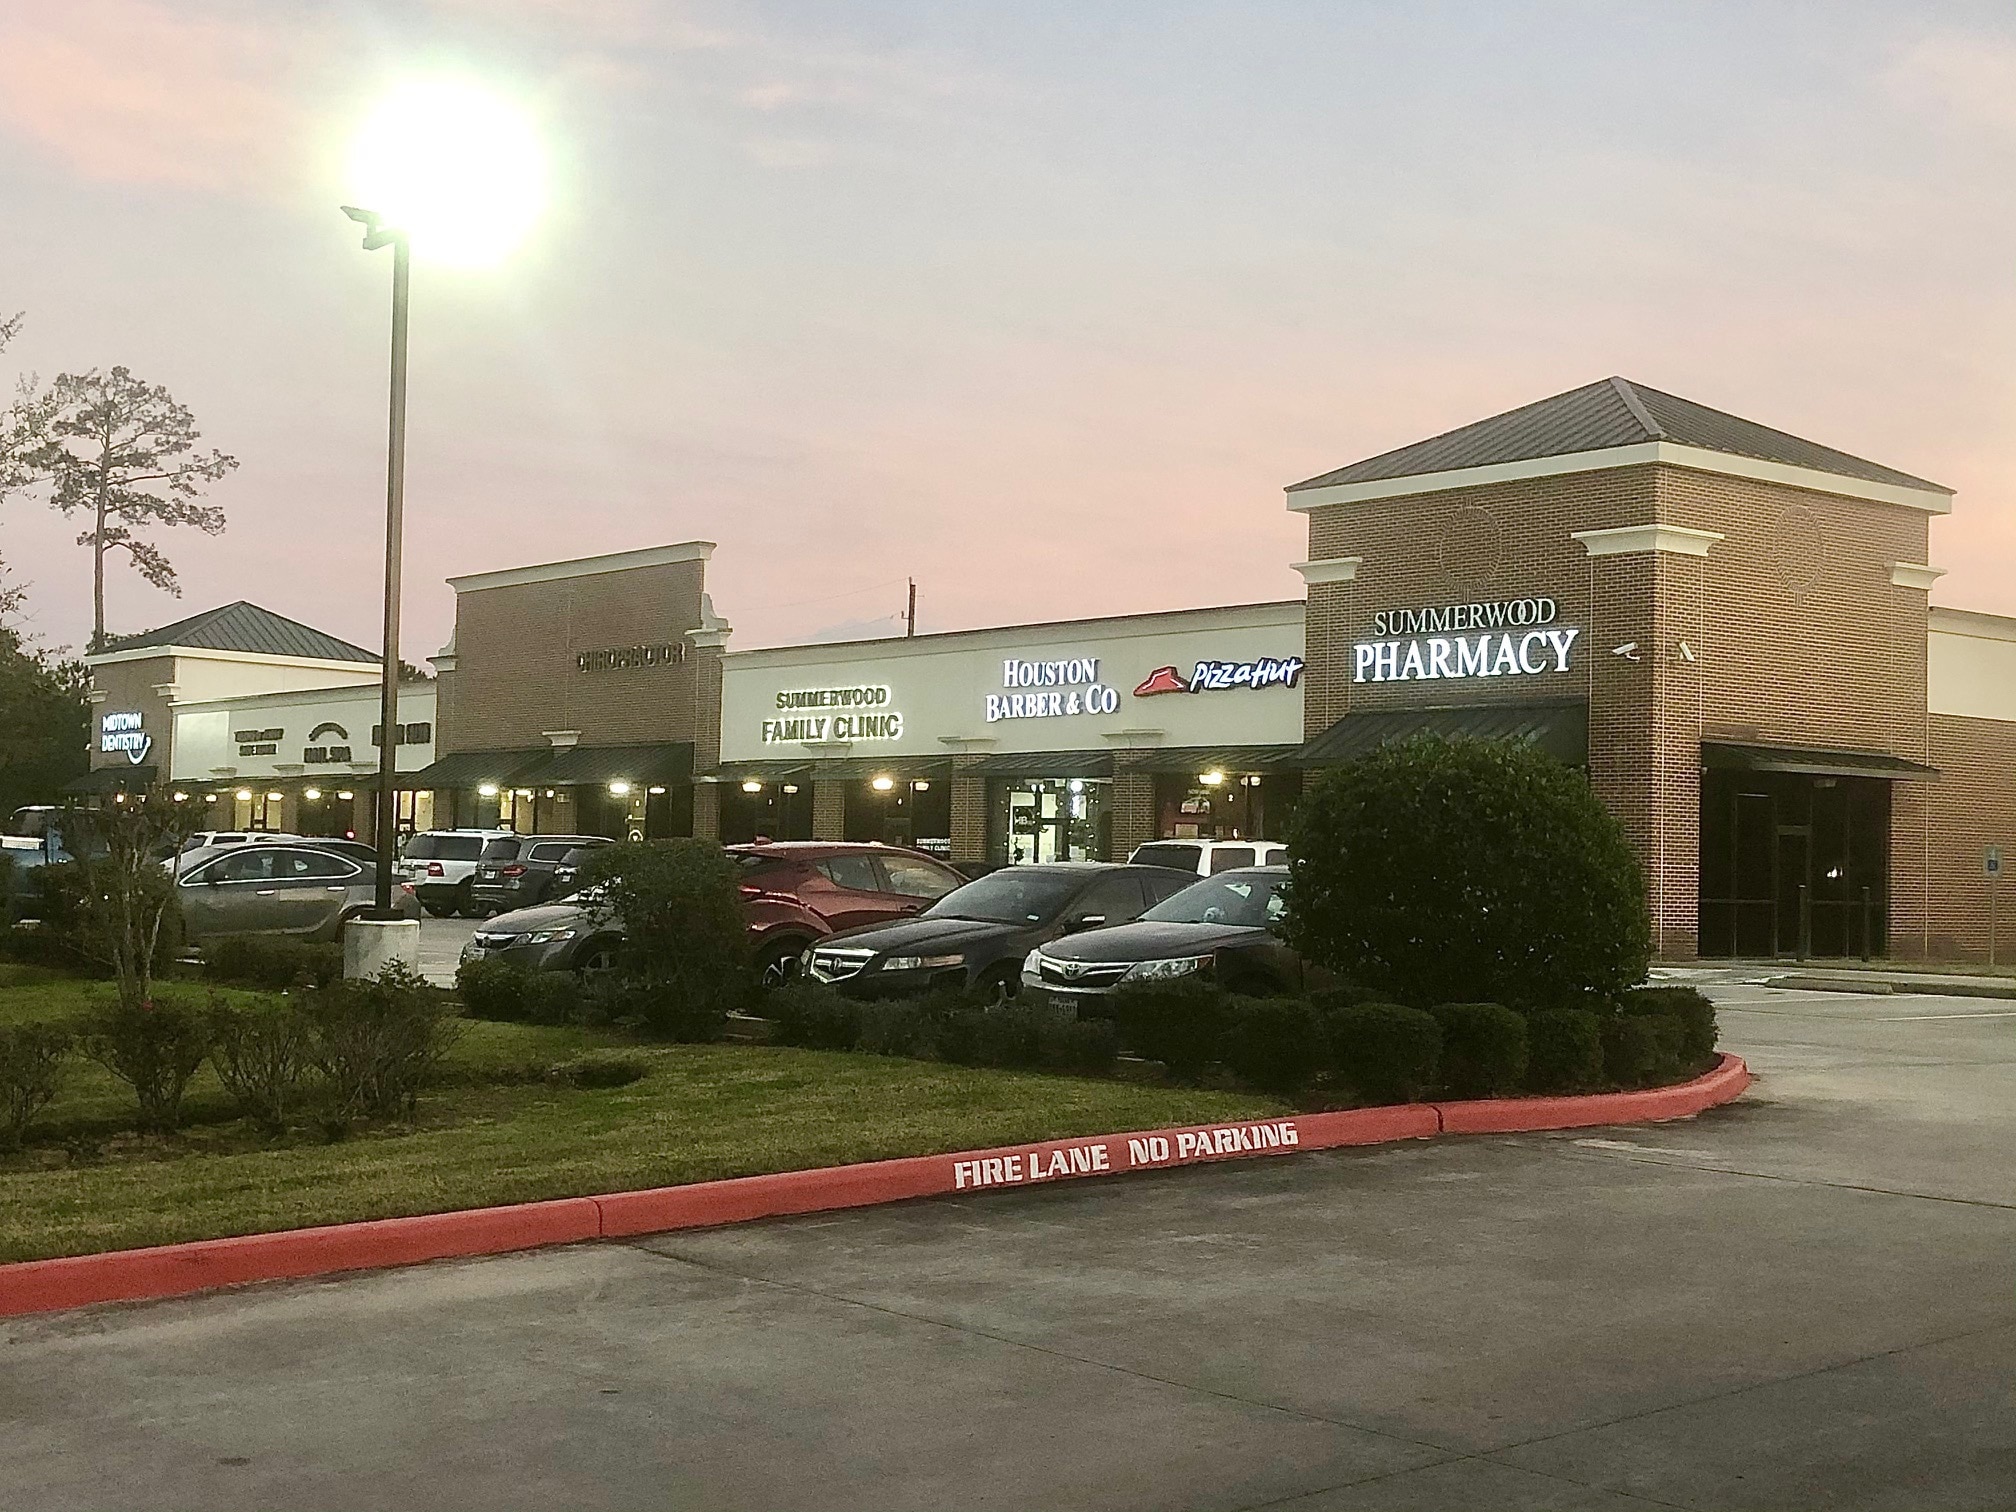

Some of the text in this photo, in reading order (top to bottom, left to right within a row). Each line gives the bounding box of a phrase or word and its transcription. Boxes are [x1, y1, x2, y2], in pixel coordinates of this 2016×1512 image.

[1374, 599, 1556, 637] SUMMERWOOD
[1353, 629, 1579, 683] PHARMACY
[1003, 657, 1099, 687] HOUSTON
[775, 686, 888, 710] SUMMERWOOD
[986, 691, 1062, 722] BARBER
[1066, 692, 1080, 715] &
[102, 712, 142, 732] MIDTOWN
[761, 714, 899, 743] FAMILY CLINIC
[101, 732, 146, 752] DENTISTRY
[953, 1122, 1299, 1188] FIRE LANE NO PARKING
